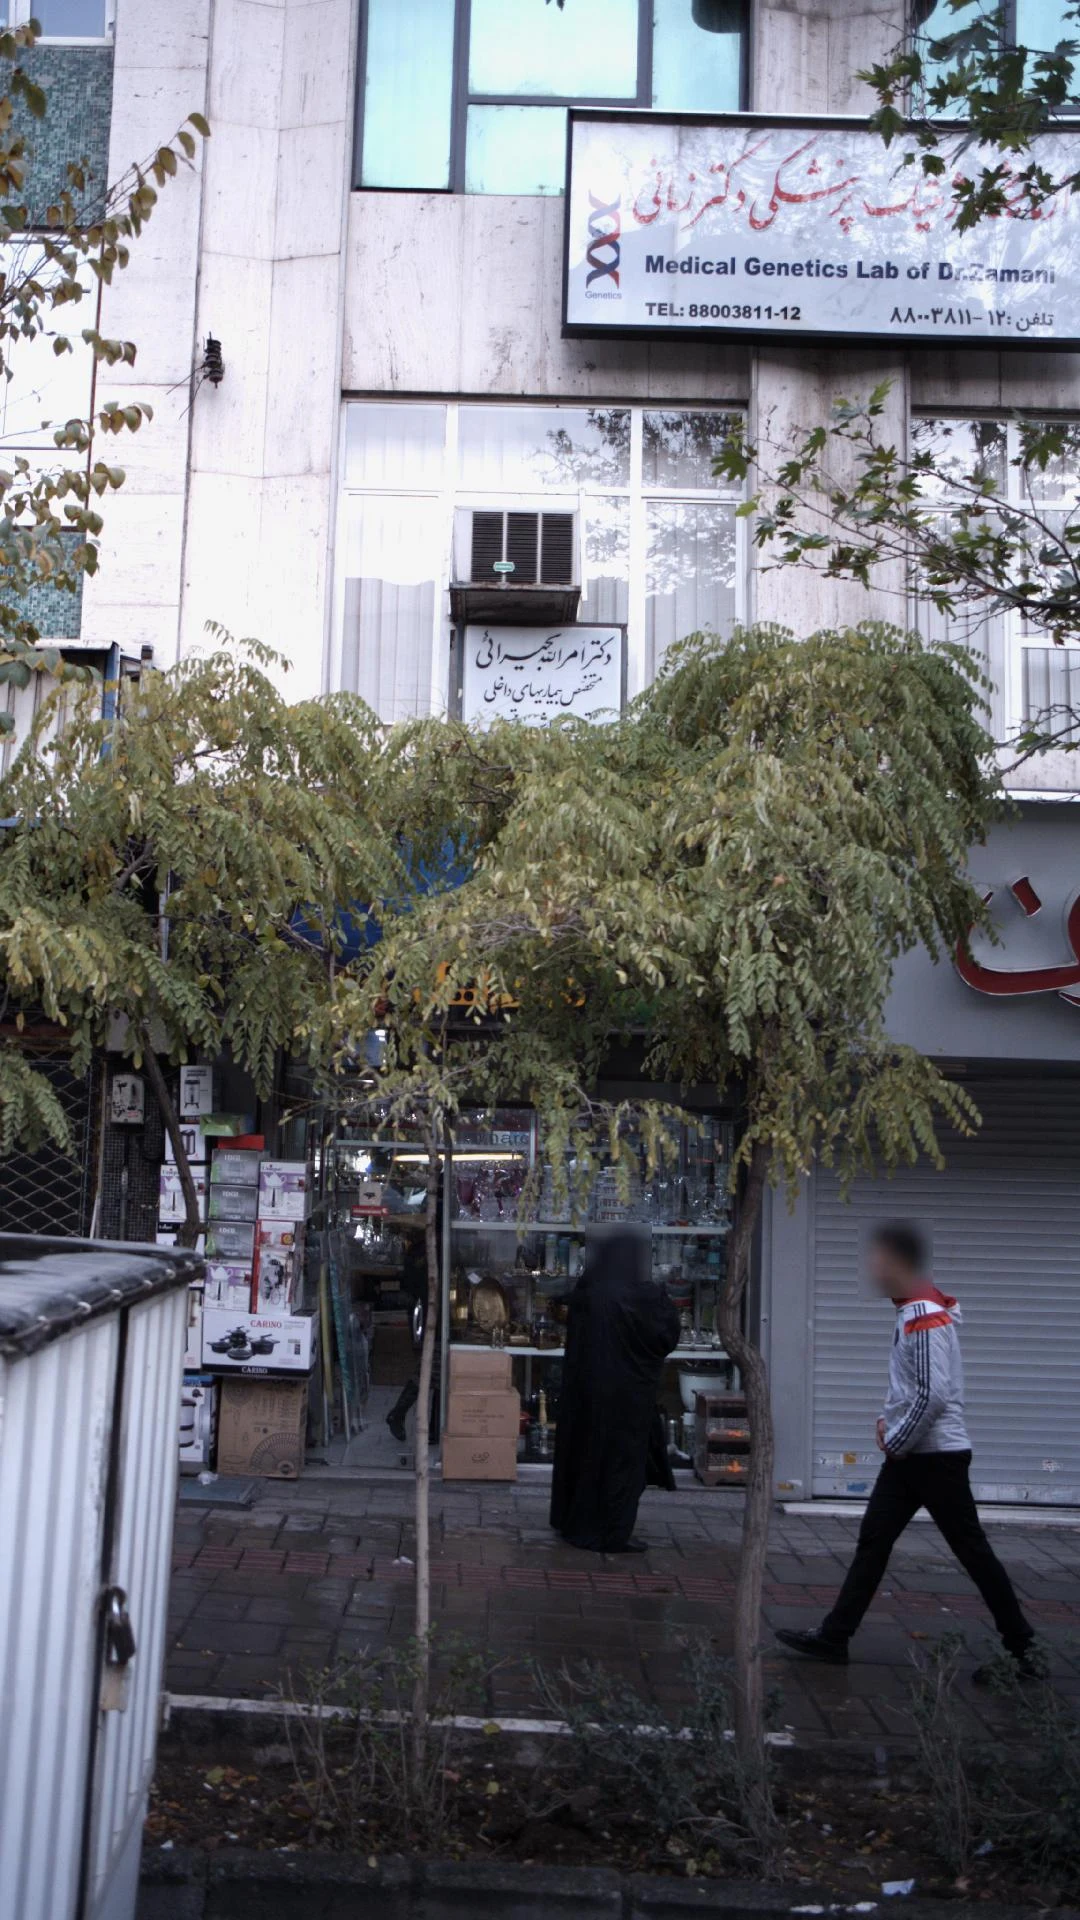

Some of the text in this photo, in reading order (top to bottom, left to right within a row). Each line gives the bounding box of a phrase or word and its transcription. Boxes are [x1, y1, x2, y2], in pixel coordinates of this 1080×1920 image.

[633, 158, 694, 225] زمانی
[681, 134, 773, 231] دکتر
[645, 255, 736, 276] Medical
[744, 257, 848, 279] Genetics
[856, 261, 899, 279] Lab
[907, 262, 930, 280] of
[585, 290, 622, 300] Genetics
[645, 302, 801, 321] TEL: 88003811-12
[581, 636, 615, 670] دکتر
[484, 676, 512, 702] داخلی
[560, 673, 602, 706] متخصص
[250, 1319, 282, 1328] CARINO
